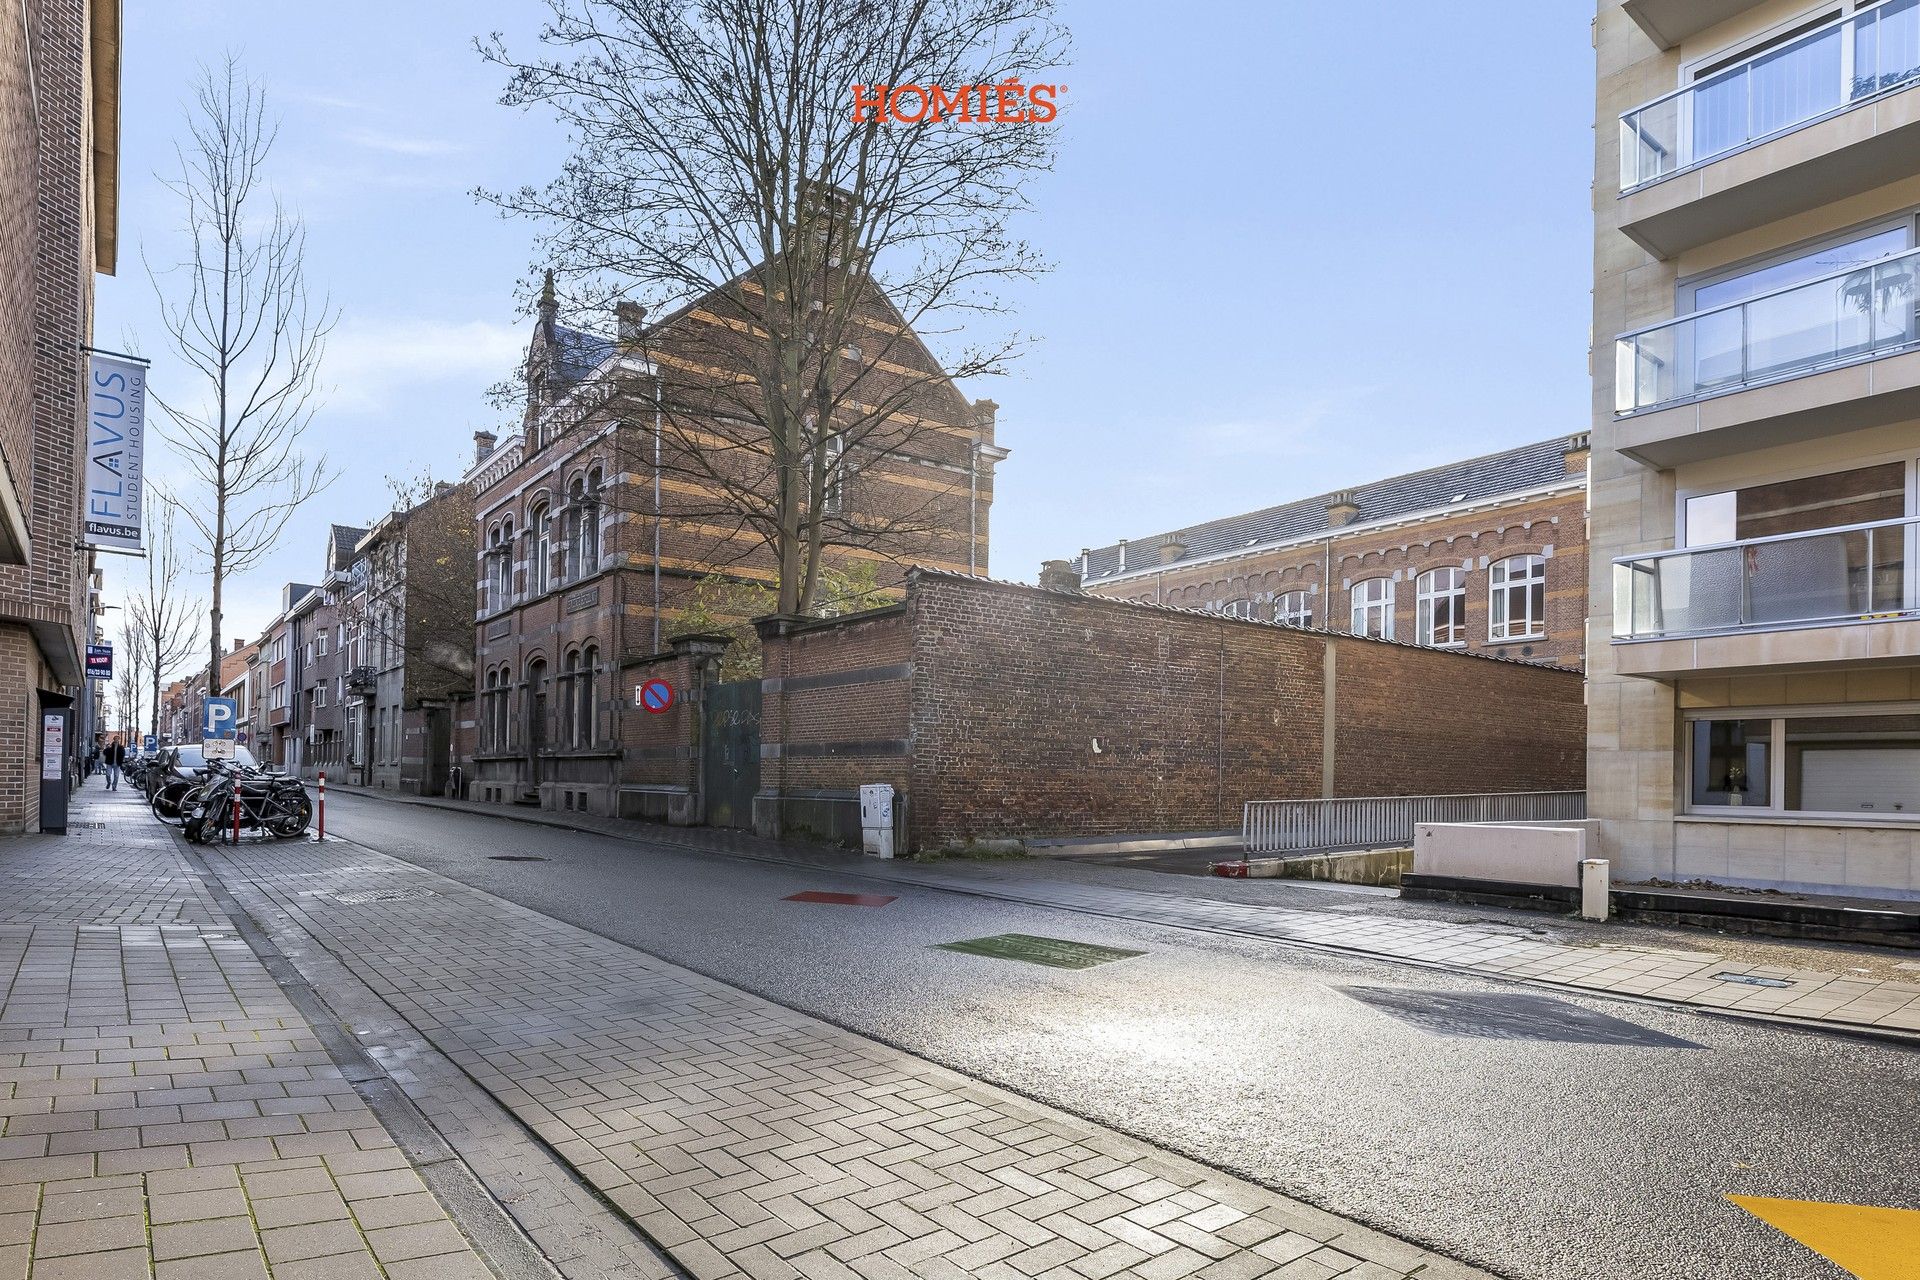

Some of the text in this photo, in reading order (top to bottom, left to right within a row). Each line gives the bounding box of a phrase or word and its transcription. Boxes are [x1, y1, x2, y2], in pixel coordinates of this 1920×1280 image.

[91, 370, 126, 518] FLAVUS
[126, 377, 141, 520] STUDENT HOUSING
[88, 522, 138, 538] flavus.be
[208, 703, 231, 733] P
[146, 737, 155, 749] P
